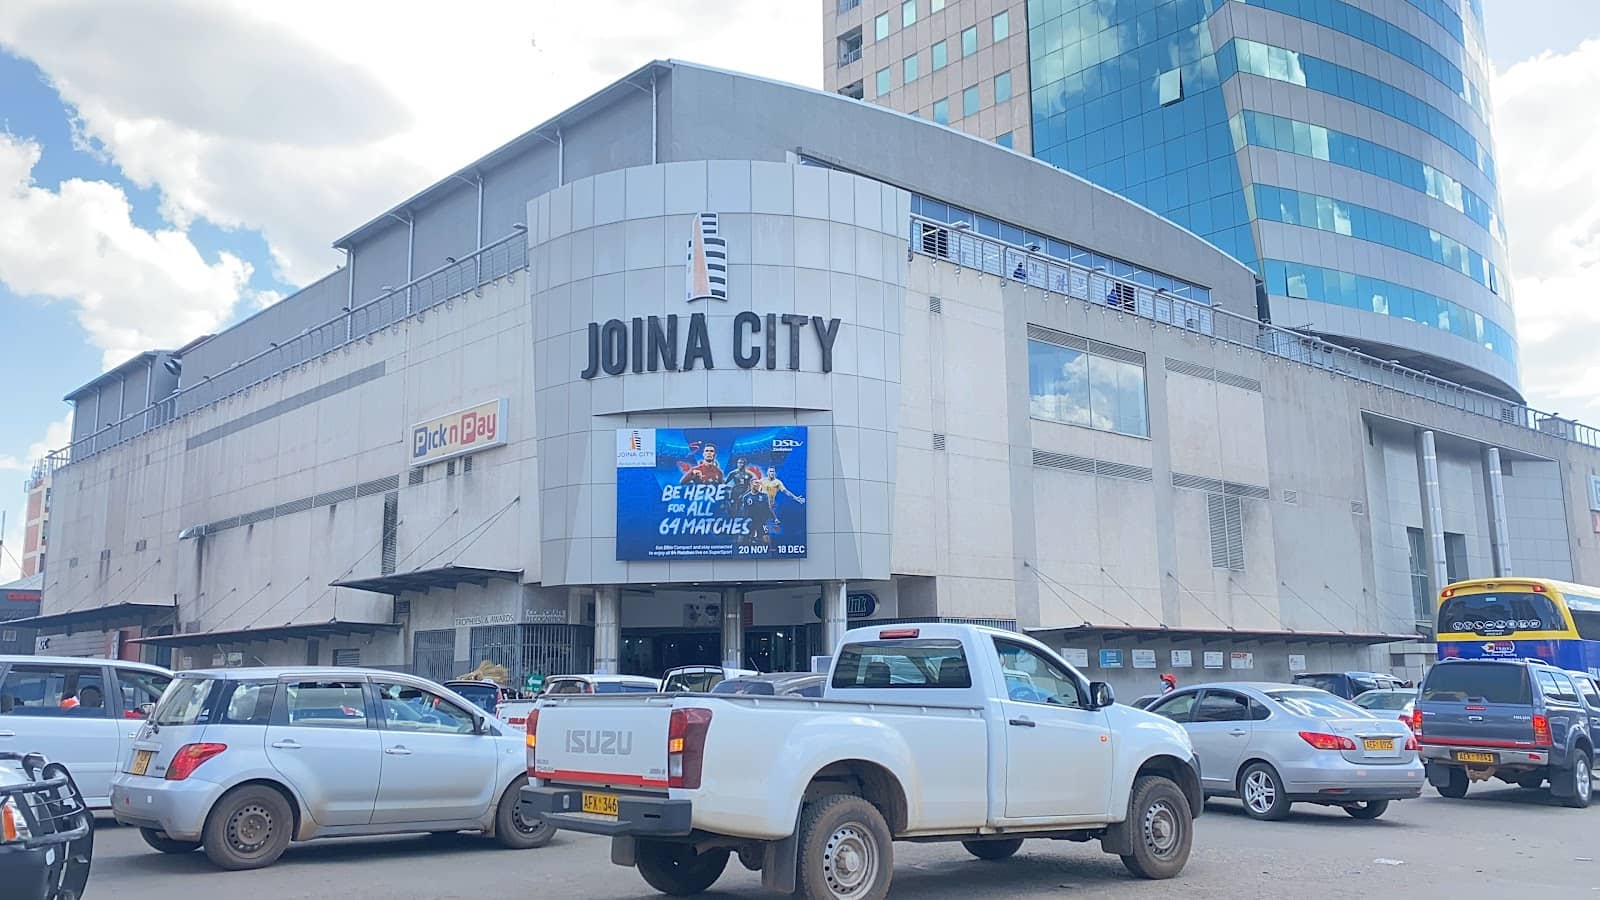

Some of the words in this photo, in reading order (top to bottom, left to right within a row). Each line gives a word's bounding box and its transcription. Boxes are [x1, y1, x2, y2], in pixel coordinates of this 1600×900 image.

[581, 312, 714, 380] JOINA
[733, 310, 841, 373] CITY
[414, 423, 447, 458] Pick
[449, 424, 458, 445] n
[461, 412, 496, 445] Pay
[662, 484, 682, 502] BE
[684, 484, 726, 503] HERE
[668, 504, 685, 513] FOR
[687, 501, 713, 517] ALL
[659, 517, 681, 535] 64
[682, 517, 752, 535] MATCHES
[738, 545, 750, 554] 20
[751, 545, 769, 554] NOV
[777, 545, 787, 553] 18
[788, 545, 805, 553] DEC
[565, 729, 633, 756] ISUZU
